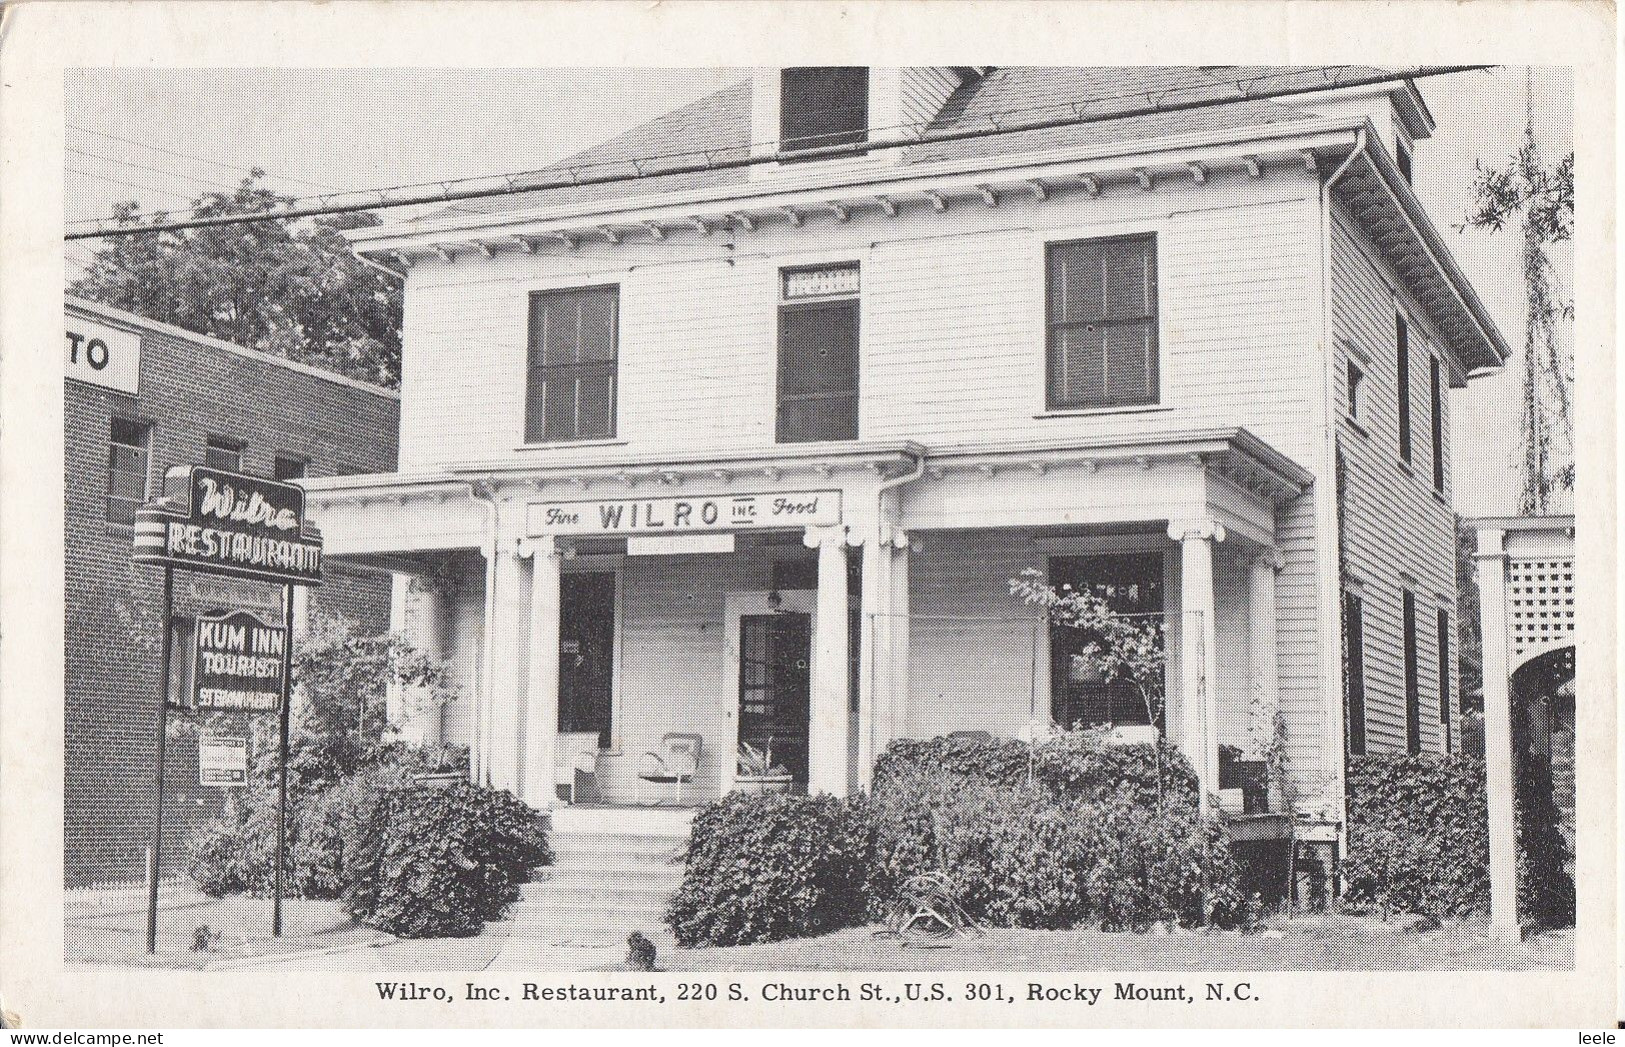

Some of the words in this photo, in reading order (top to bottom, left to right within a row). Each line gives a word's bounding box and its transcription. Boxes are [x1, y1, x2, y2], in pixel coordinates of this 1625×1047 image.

[66, 330, 109, 371] TO
[198, 477, 299, 531] Wilro
[545, 508, 579, 525] Fine
[599, 501, 718, 529] WILRO
[772, 497, 818, 516] Food
[167, 521, 321, 572] RESTAURANT
[199, 621, 246, 652] KUM
[252, 627, 284, 656] INN
[202, 652, 282, 678] TOURIST
[376, 983, 454, 1003] Wilro,
[466, 983, 509, 1000] Inc.
[522, 983, 664, 1003] Restaurant,
[678, 984, 717, 1000] 220
[730, 984, 750, 1000] S.
[762, 983, 850, 1000] Church
[966, 984, 1015, 1003] 301,
[1027, 983, 1102, 1005] Rocky
[1114, 983, 1193, 1003] Mount,
[1206, 983, 1259, 1001] N.C.
